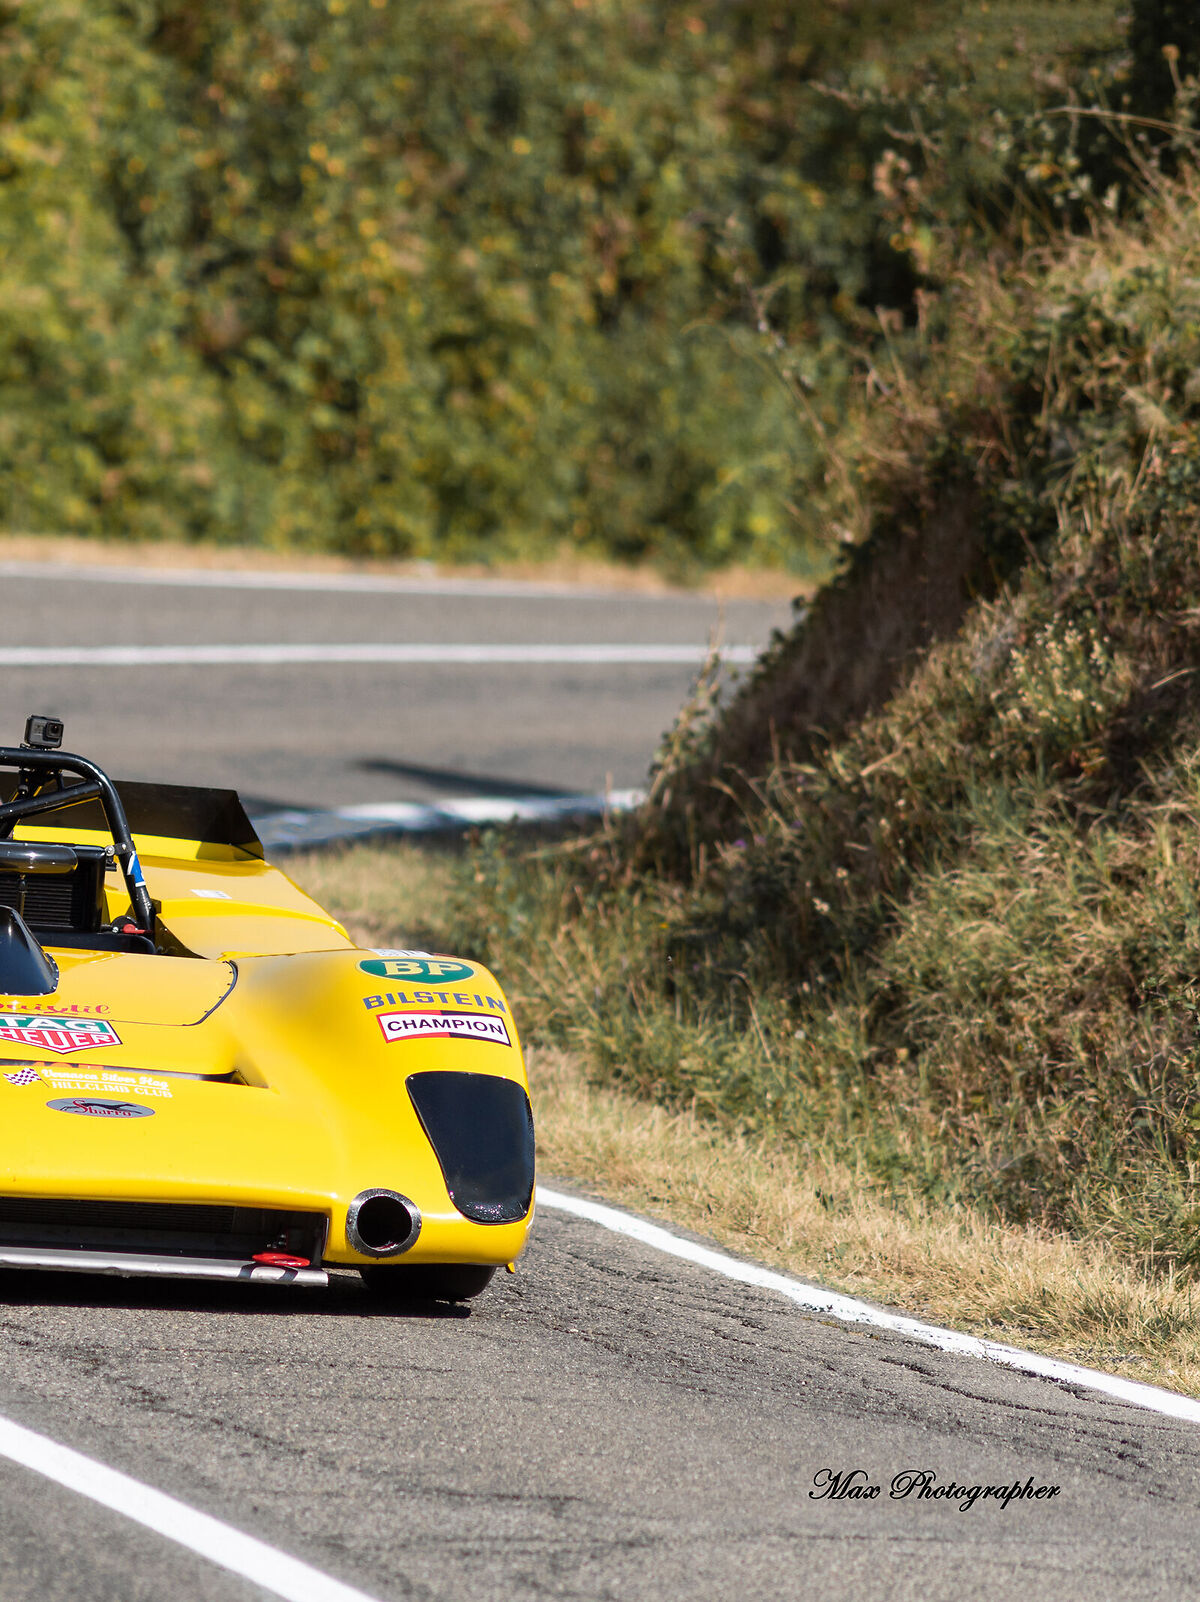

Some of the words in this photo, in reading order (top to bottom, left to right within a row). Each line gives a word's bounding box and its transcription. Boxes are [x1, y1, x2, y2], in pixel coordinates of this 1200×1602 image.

[382, 961, 463, 977] BP
[362, 991, 506, 1014] BILSTEIN
[387, 1018, 504, 1035] CHAMPION
[52, 1081, 130, 1094] HILLCLIMB
[134, 1087, 173, 1098] CLUB
[72, 1099, 132, 1117] Sbarro
